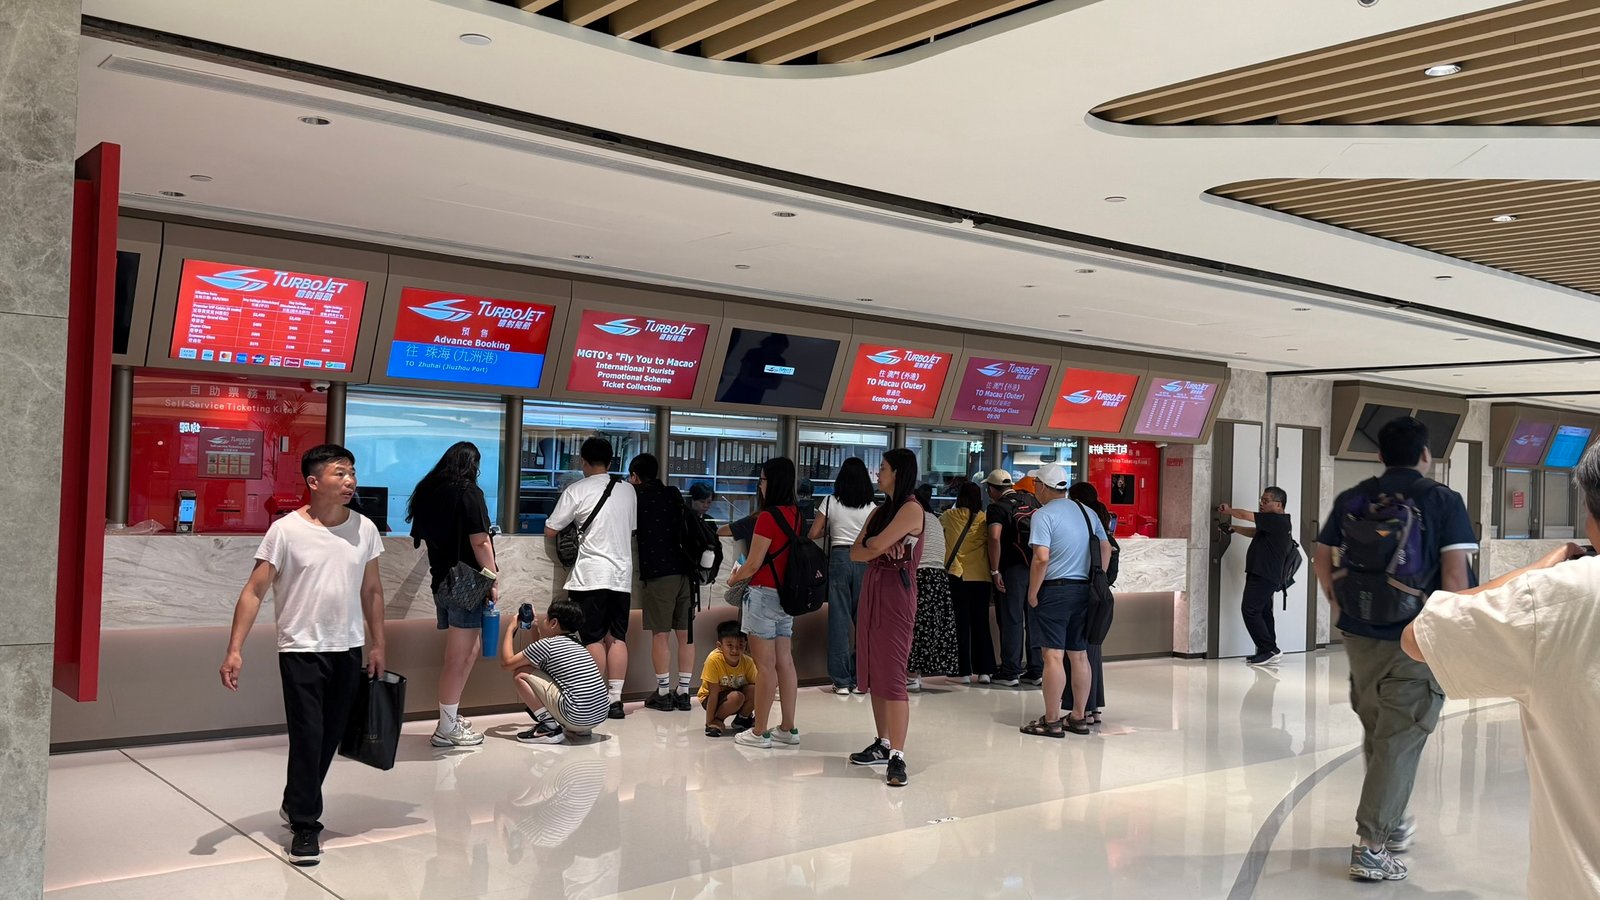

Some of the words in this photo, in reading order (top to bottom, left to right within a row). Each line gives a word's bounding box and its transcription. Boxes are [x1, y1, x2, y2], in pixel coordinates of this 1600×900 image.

[434, 335, 472, 346] Advance
[475, 338, 511, 351] Booking
[405, 343, 418, 358] 往
[577, 349, 613, 360] MGTO's
[616, 353, 633, 364] "Fly
[636, 354, 652, 364] You
[655, 357, 664, 365] to
[442, 363, 470, 372] (Jiuzhou
[472, 365, 488, 373] Port)
[596, 362, 645, 373] International
[647, 366, 675, 375] Tourists
[597, 371, 642, 381] Promotional
[643, 375, 672, 384] Scheme
[602, 381, 624, 389] Ticket
[626, 382, 661, 391] Collection
[878, 379, 899, 388] Macau
[901, 381, 926, 391] (Outer)
[190, 384, 277, 401] 自助票務機
[984, 390, 1002, 398] Macau
[1003, 391, 1025, 400] (Outer)
[872, 395, 896, 404] Economy
[897, 397, 912, 405] Class
[165, 399, 224, 410] Self-Service
[227, 402, 271, 414] Ticketing
[882, 403, 898, 411] 09:00
[977, 405, 1007, 414] Grand/Super
